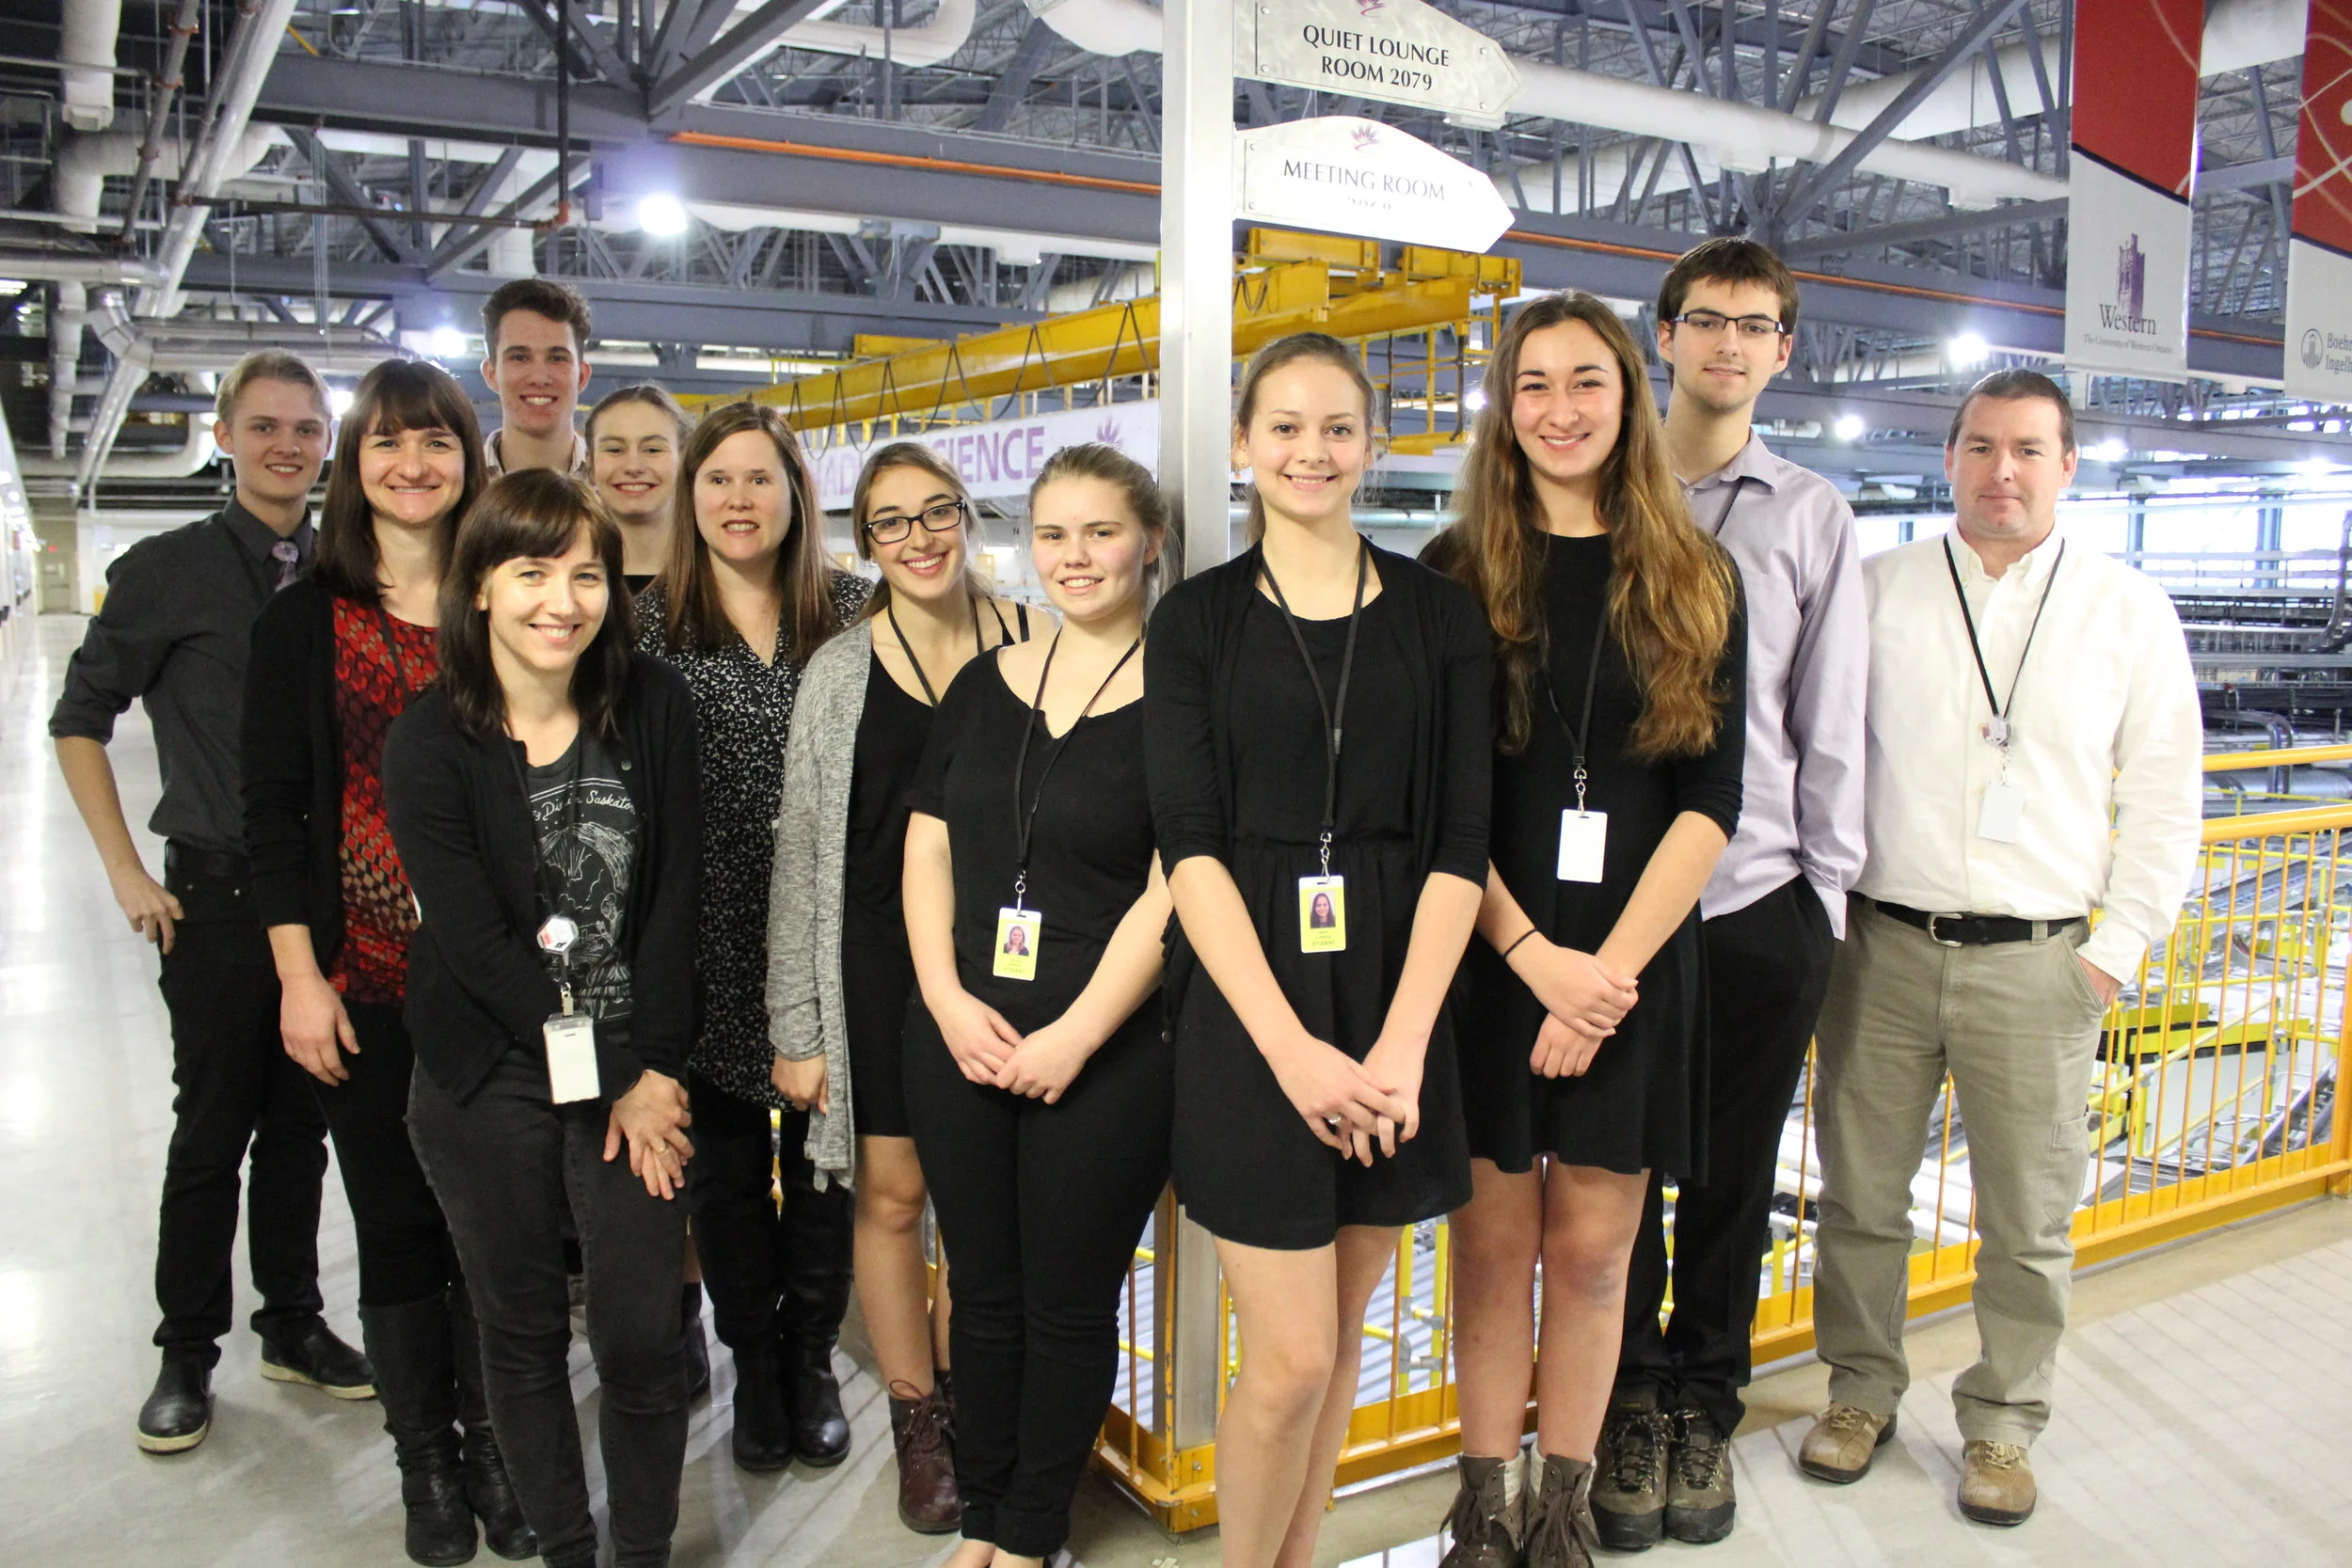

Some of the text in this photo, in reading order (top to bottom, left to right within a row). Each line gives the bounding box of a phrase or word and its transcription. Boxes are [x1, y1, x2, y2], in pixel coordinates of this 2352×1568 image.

[1303, 24, 1449, 67] QUIET LOUNGE
[1322, 55, 1433, 90] ROOM 2079
[1283, 159, 1445, 200] MEETING ROOM
[2099, 304, 2156, 335] Western
